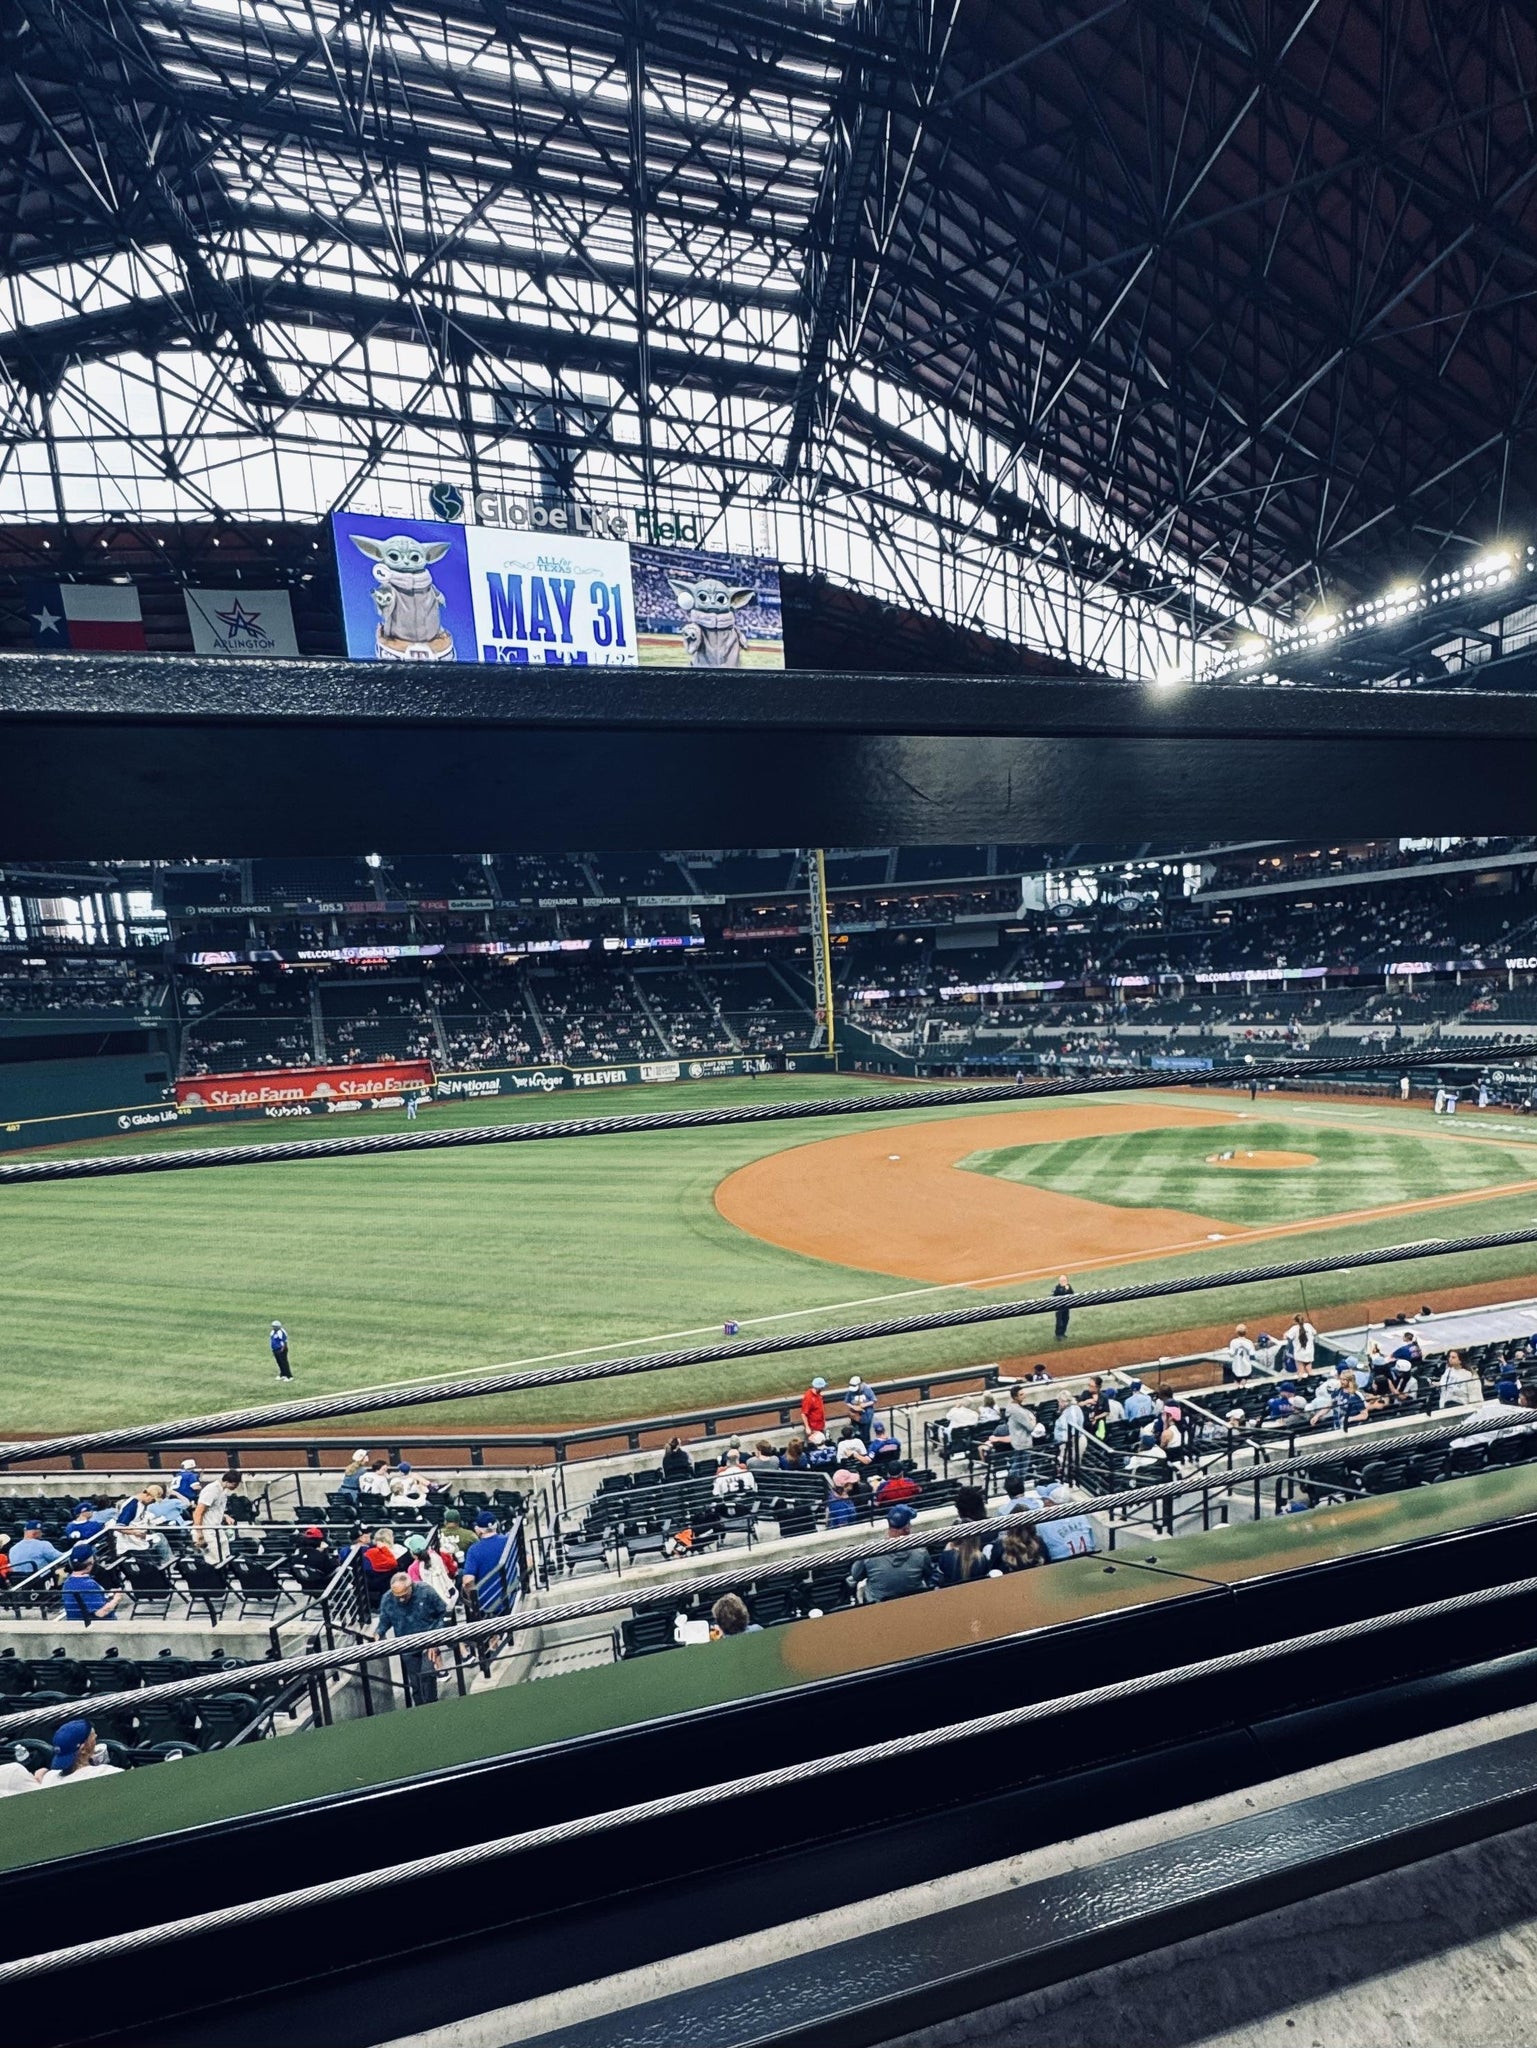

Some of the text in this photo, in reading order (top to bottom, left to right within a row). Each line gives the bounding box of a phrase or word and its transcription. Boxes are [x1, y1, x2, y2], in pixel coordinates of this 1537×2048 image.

[475, 491, 699, 544] Globe Life Field
[538, 563, 572, 575] TEXAS
[486, 571, 627, 648] MAY 31
[213, 638, 276, 650] ARLINGTON
[197, 904, 272, 914] PRIORITY COMMERCE
[318, 902, 344, 913] 105.3
[298, 949, 341, 960] WELCOME
[359, 947, 383, 957] Globe
[528, 1071, 564, 1092] Kroger
[1505, 1073, 1537, 1084] Medical
[131, 1109, 178, 1126] Globe Life
[265, 1104, 312, 1118] Kubota
